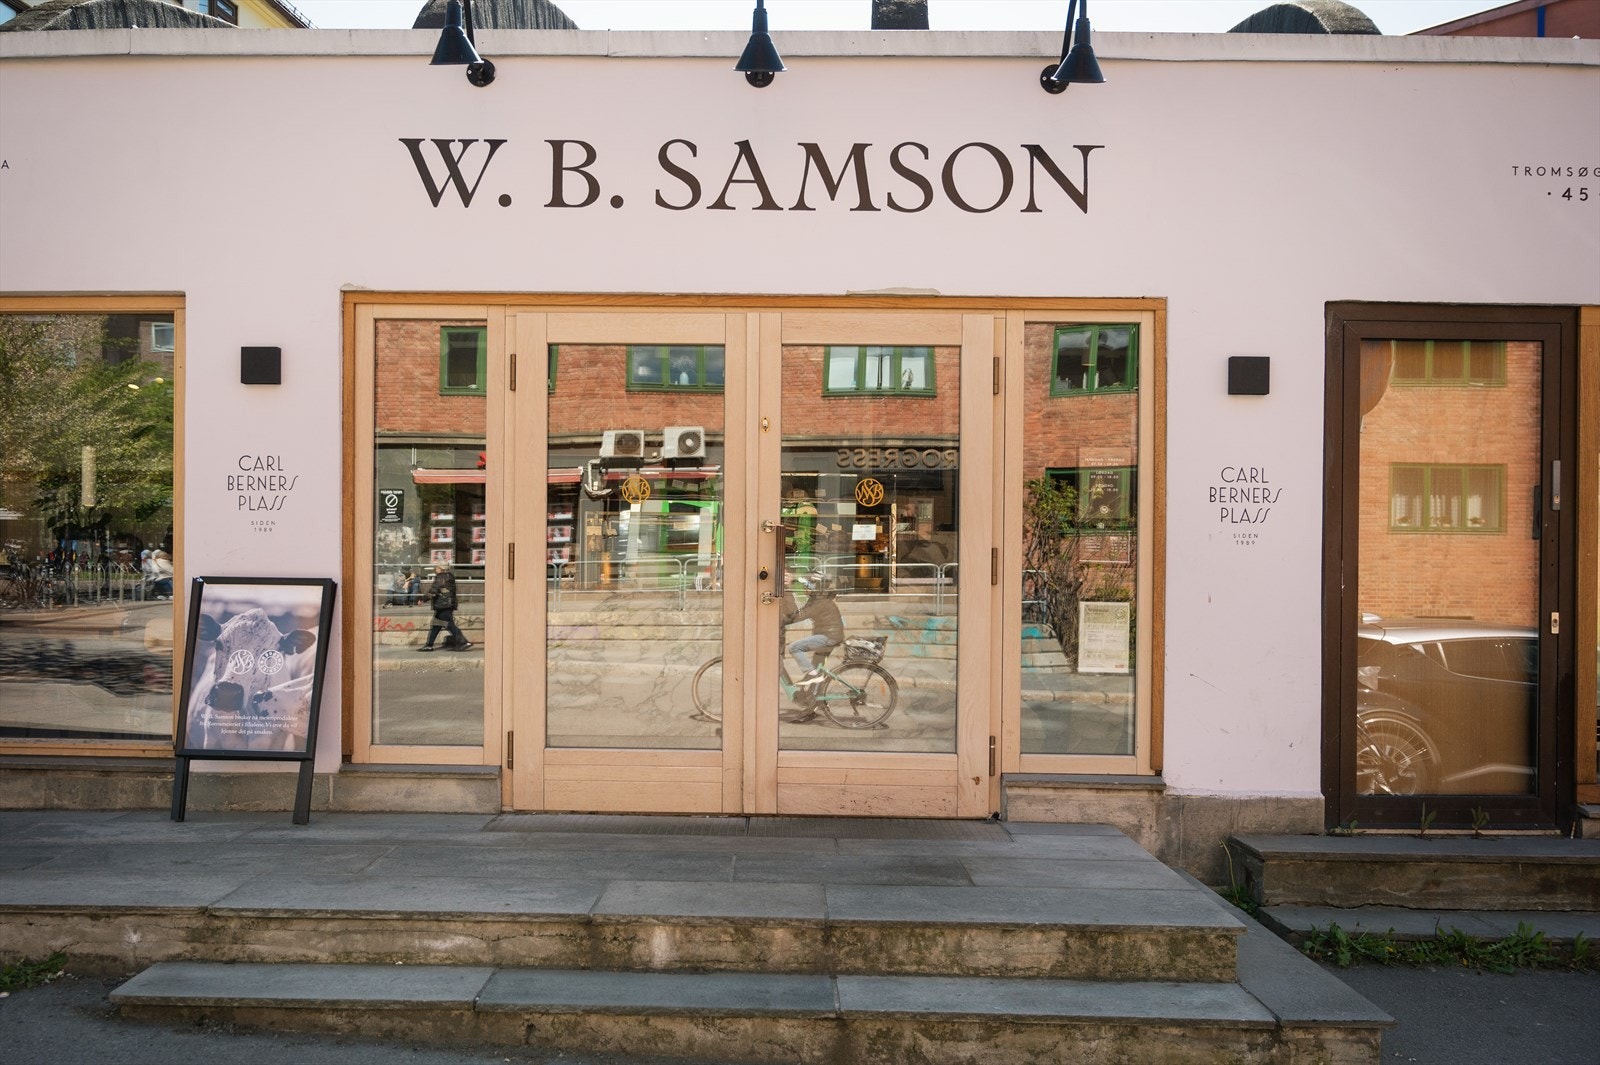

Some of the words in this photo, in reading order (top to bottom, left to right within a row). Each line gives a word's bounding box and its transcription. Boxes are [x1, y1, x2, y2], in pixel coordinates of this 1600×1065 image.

[398, 138, 512, 208] W.
[543, 139, 624, 208] B.
[655, 138, 1105, 215] SAMSON
[238, 454, 284, 471] CARL
[227, 474, 299, 491] BERNERS
[1220, 466, 1269, 483] CARL
[238, 495, 287, 511] PLASS
[1209, 486, 1283, 504] BERNERS
[1220, 507, 1271, 524] PLASS
